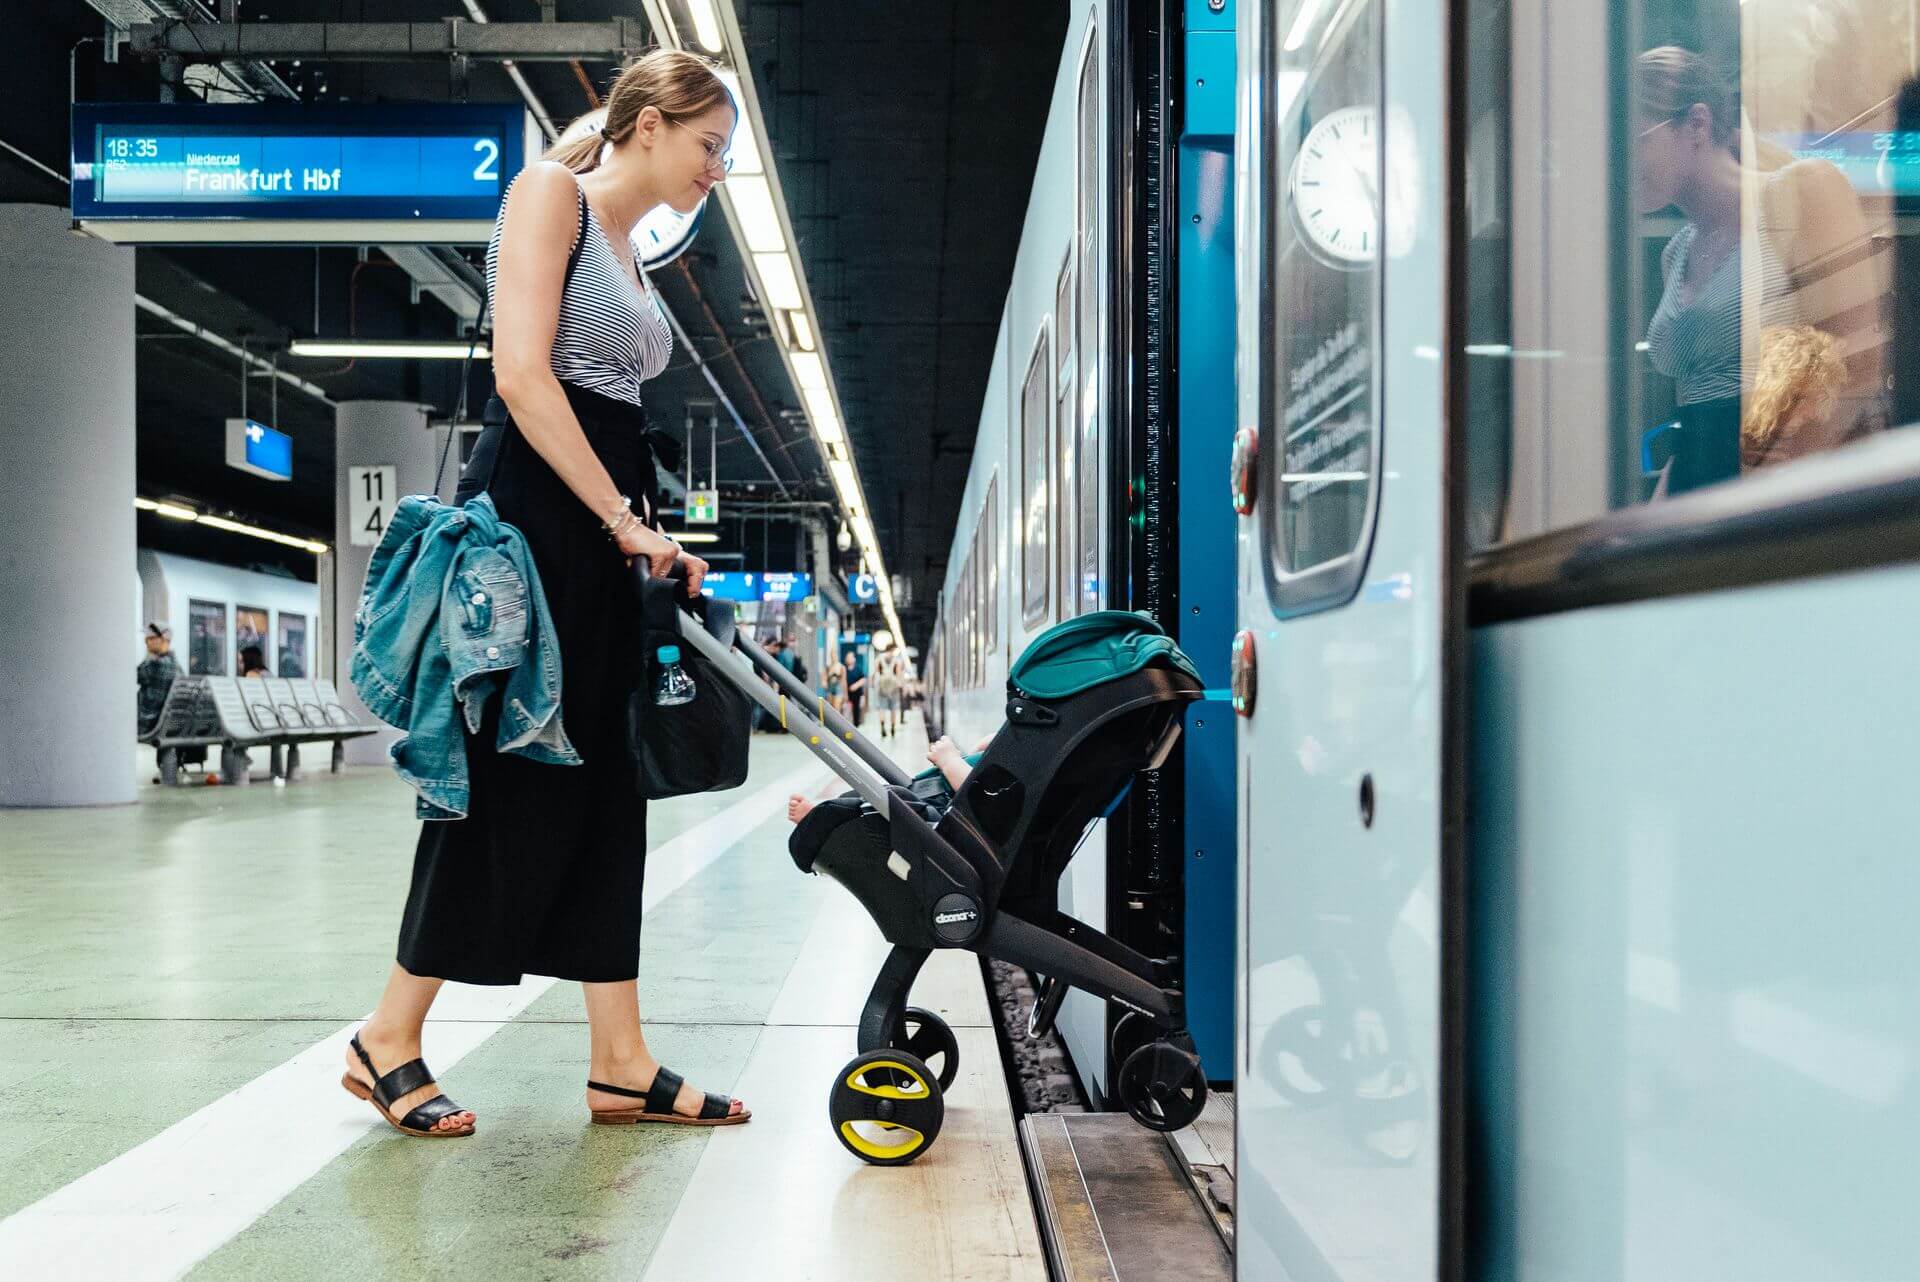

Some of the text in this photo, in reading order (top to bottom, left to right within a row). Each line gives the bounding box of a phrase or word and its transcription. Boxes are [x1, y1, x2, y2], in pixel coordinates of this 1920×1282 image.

[107, 138, 158, 157] 18:35
[472, 138, 499, 181] 2
[186, 168, 341, 190] Frankfurt Hbf
[362, 471, 384, 501] 11
[364, 506, 384, 536] 4
[855, 576, 876, 599] C
